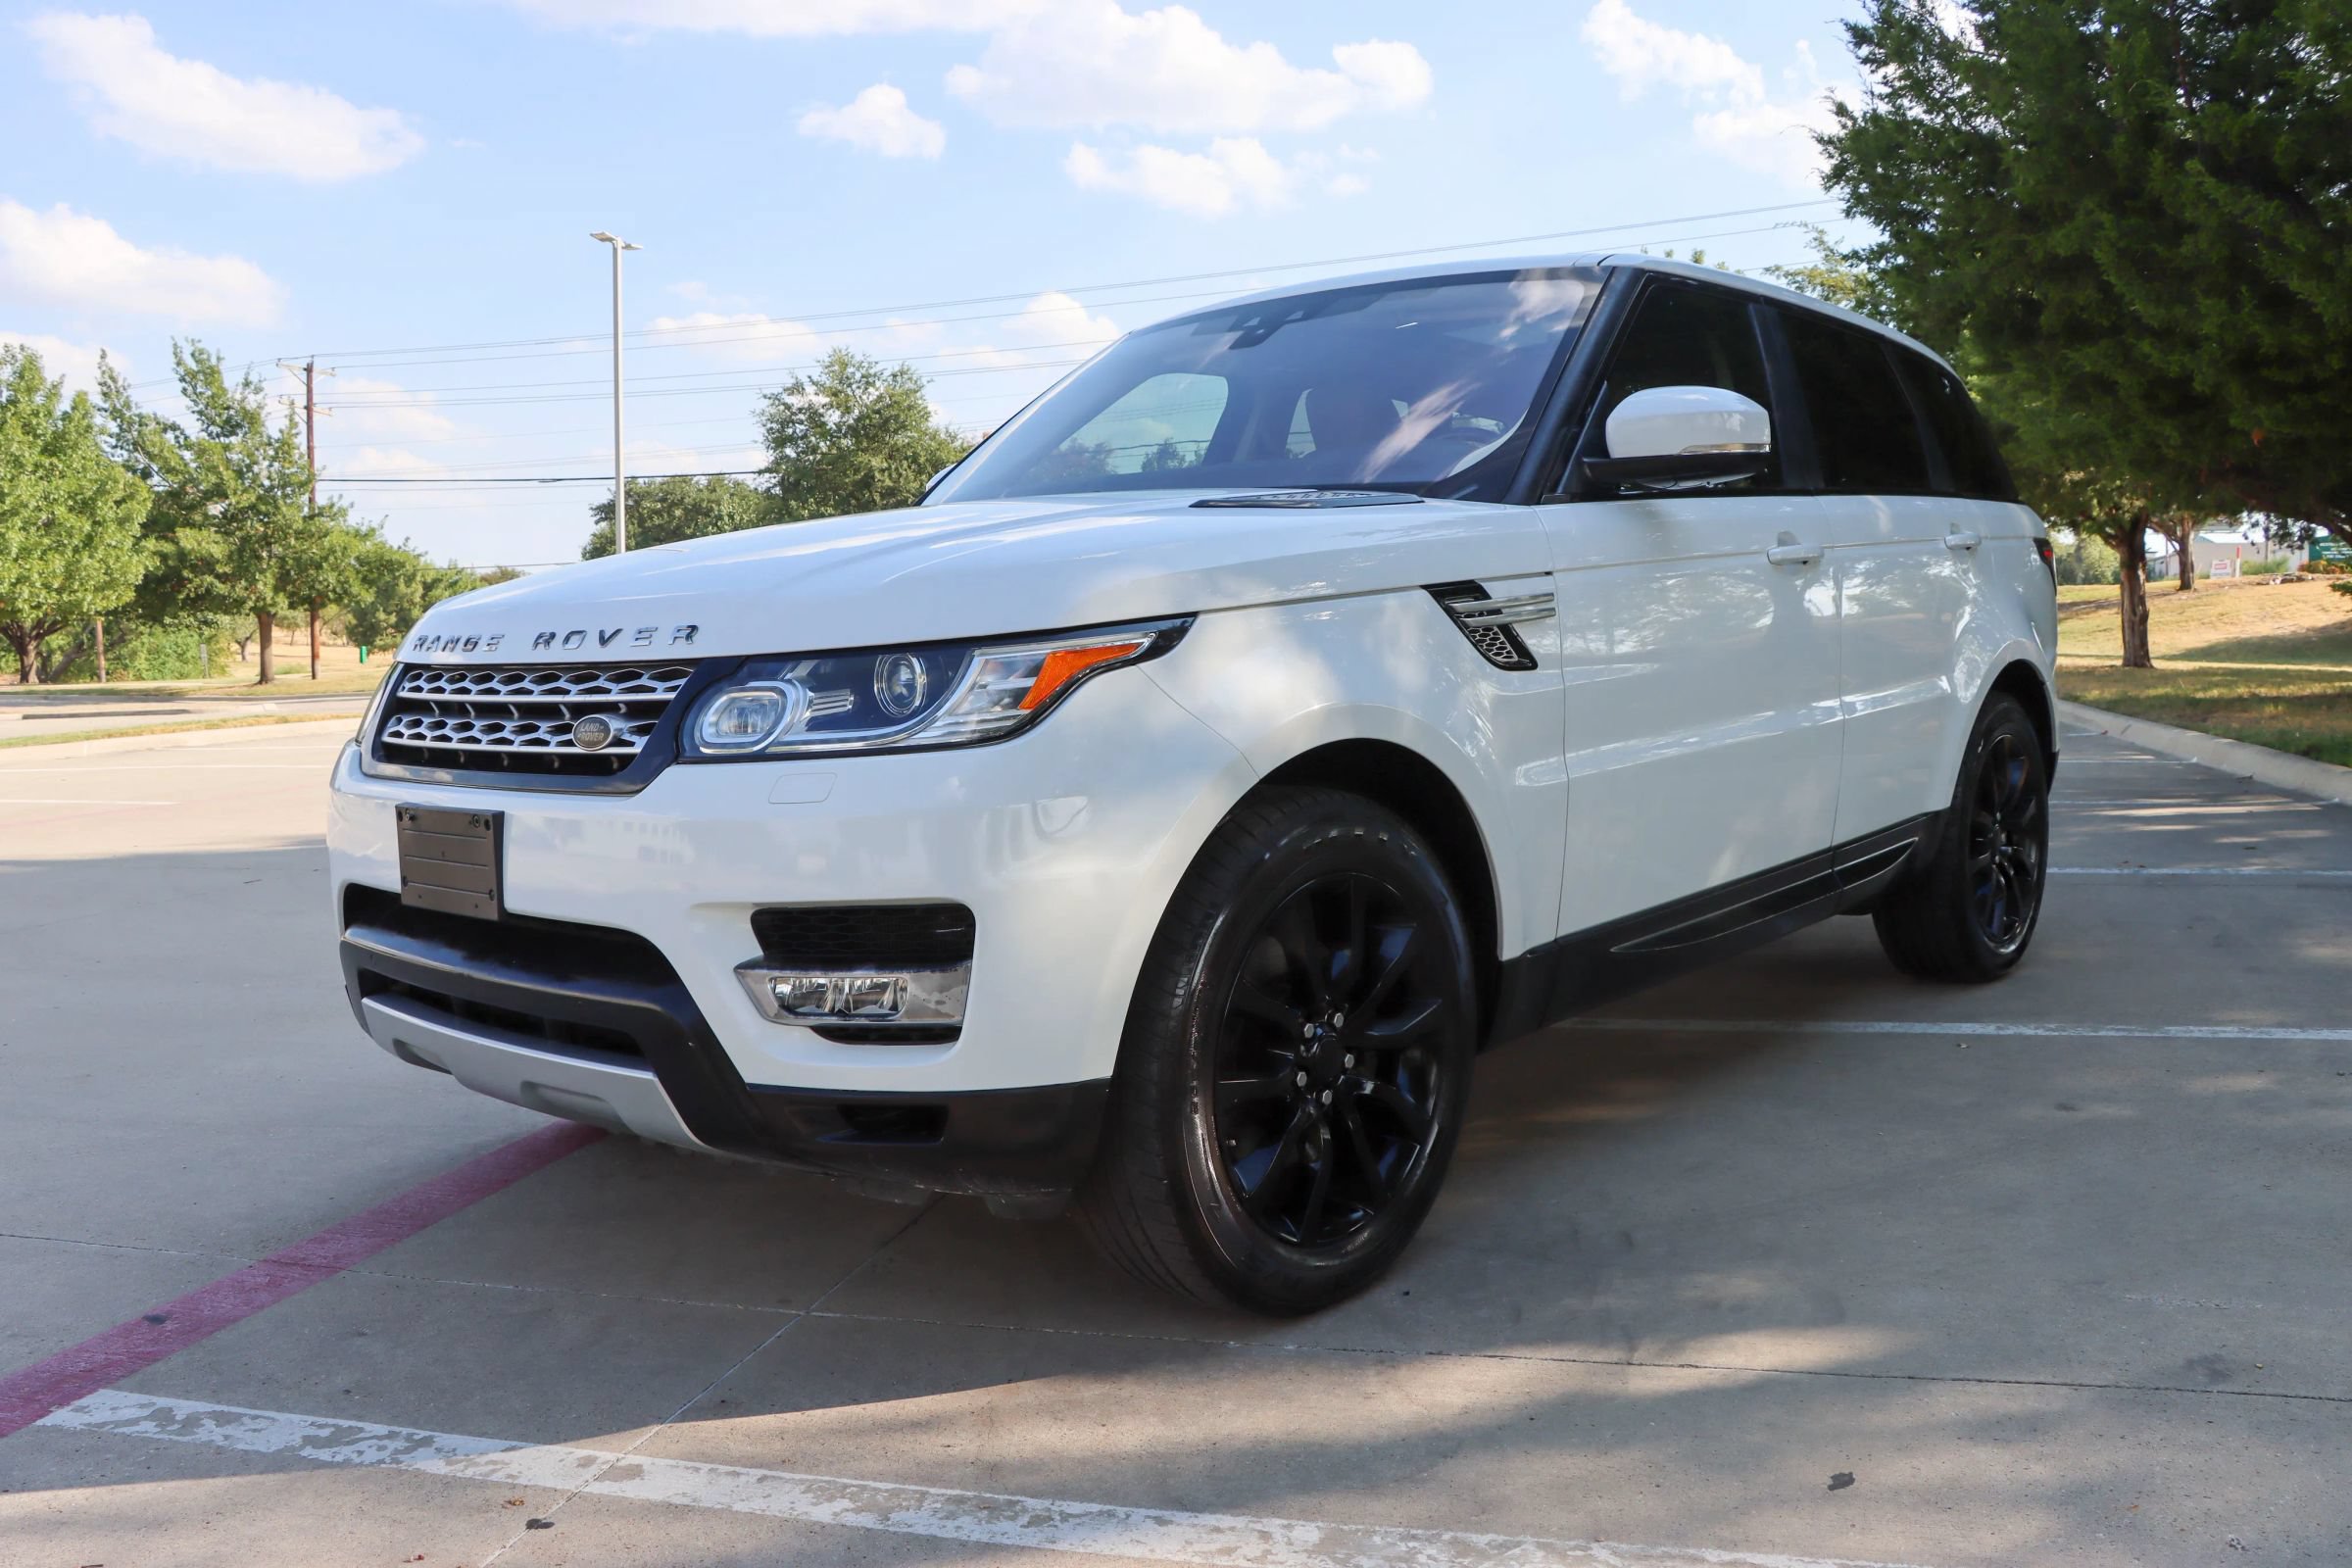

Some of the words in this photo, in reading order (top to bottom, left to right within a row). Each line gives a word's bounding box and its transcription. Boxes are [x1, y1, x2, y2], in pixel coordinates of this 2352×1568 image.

[412, 634, 506, 653] RANGE
[531, 623, 699, 651] ROVER
[579, 722, 600, 732] LAND
[581, 732, 605, 742] ROVER
